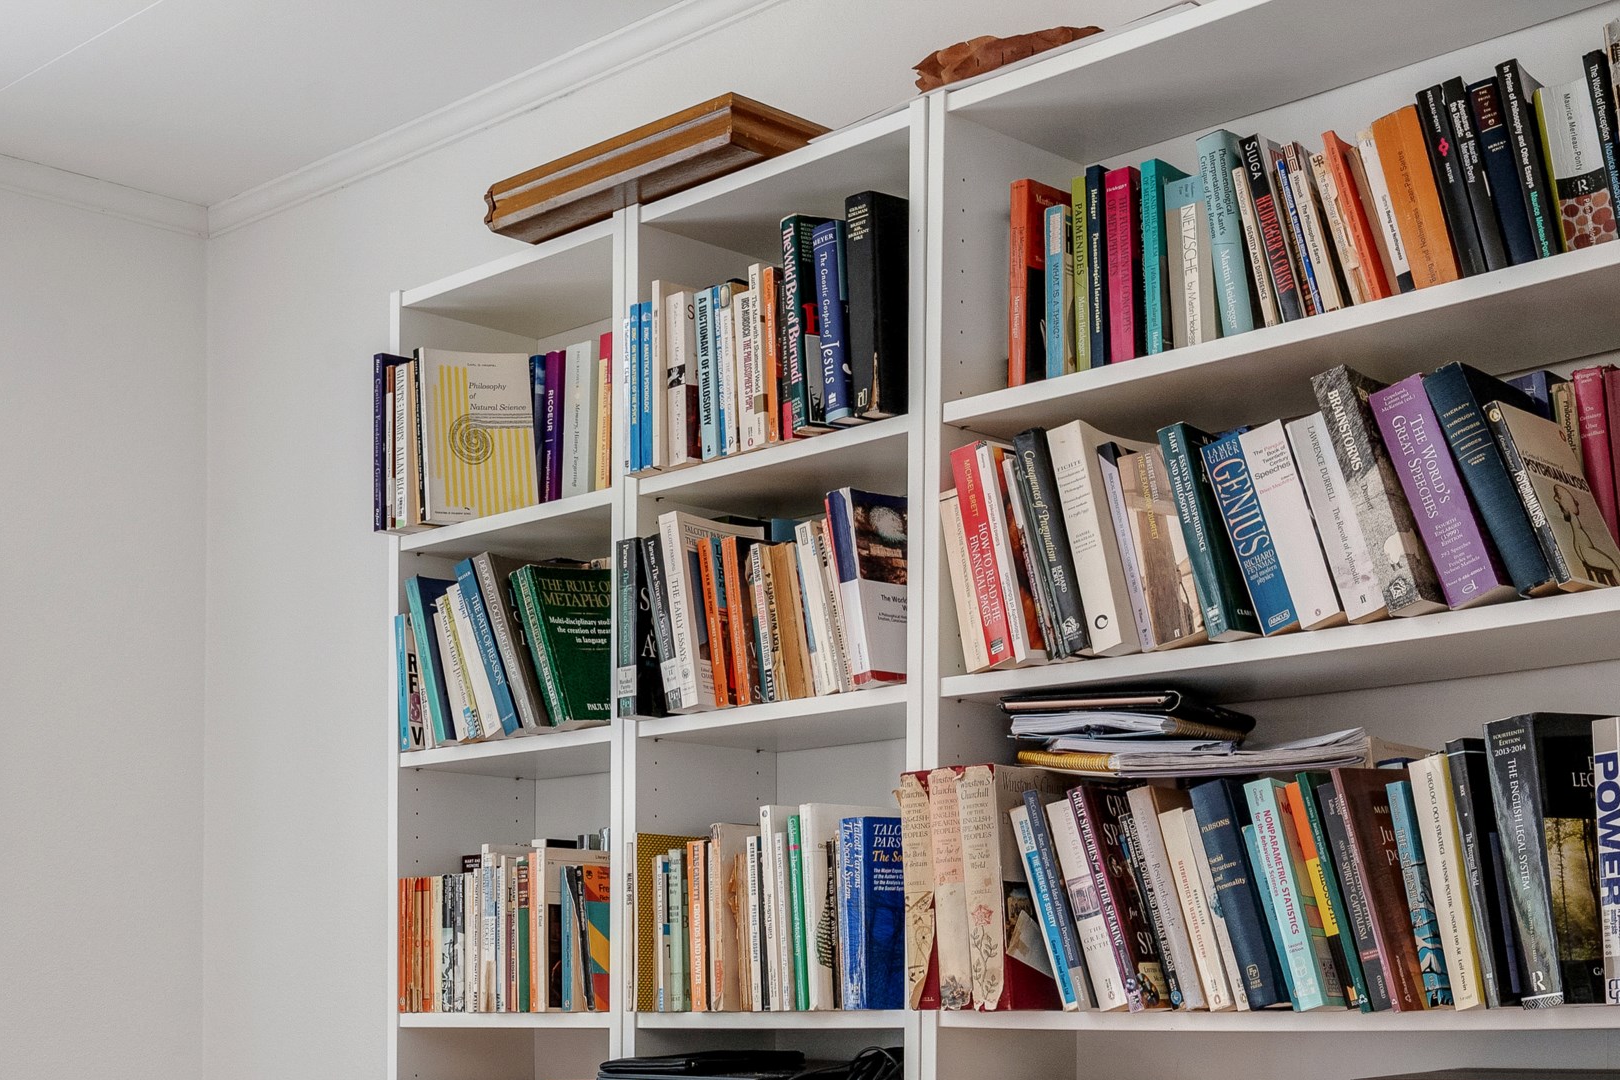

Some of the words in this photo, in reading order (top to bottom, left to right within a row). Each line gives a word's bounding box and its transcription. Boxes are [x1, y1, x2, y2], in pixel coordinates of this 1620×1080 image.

[1564, 93, 1573, 120] Maurice
[1245, 141, 1262, 180] SLUGA
[1568, 122, 1583, 171] Merleau-Ponty
[1445, 163, 1454, 183] NATURE
[783, 223, 795, 251] The
[813, 233, 834, 247] MEYER
[1075, 203, 1083, 276] PARMENIDES
[1183, 205, 1197, 276] NIETZSCHE
[1255, 194, 1280, 258] HEIDEGGER'S
[1274, 258, 1295, 293] CRISIS
[784, 250, 796, 278] Wild
[819, 252, 828, 268] The
[786, 278, 798, 309] Boy
[820, 269, 829, 297] Gnostic
[698, 297, 707, 305] A
[822, 300, 831, 327] Gospels
[787, 309, 799, 325] of
[699, 307, 710, 358] DICTIONARY
[823, 329, 831, 338] of
[701, 360, 709, 371] OF
[789, 324, 802, 384] Burundi
[819, 341, 840, 384] Jesus
[469, 382, 507, 391] Philosophy
[702, 373, 712, 426] PHILOSOPHY
[1443, 402, 1470, 419] THERAPY
[1446, 412, 1475, 428] THROUGH
[1168, 432, 1179, 454] HART
[1450, 422, 1480, 439] HYPNOSIS
[1207, 439, 1237, 457] JAMES
[1209, 447, 1240, 464] GLEICK
[1327, 388, 1363, 471] BRAINSTORMS
[1362, 484, 1373, 511] Dennett
[1409, 414, 1424, 445] THE
[1424, 444, 1451, 504] WORLD'S
[1255, 462, 1291, 480] Speeches
[1307, 425, 1323, 464] LAWRENCE
[1321, 464, 1336, 502] DURRELL
[1392, 415, 1414, 455] GREAT
[1409, 458, 1438, 519] SPEECHES
[1524, 457, 1590, 492] PSYCHOANALYSIS
[964, 460, 973, 490] MICHAEL
[970, 491, 979, 517] BRETT
[1174, 475, 1190, 524] PHILOSOPHY
[1515, 470, 1545, 527] PSYCHOANALYSIS
[1023, 450, 1042, 502] Consequences
[1039, 507, 1057, 562] Pragmatism
[1179, 454, 1189, 482] ESSAYS
[1187, 490, 1206, 552] JURISPRUDENCE
[1213, 458, 1269, 556] GENIUS
[978, 522, 990, 549] HOW
[983, 550, 992, 567] TO
[1243, 549, 1275, 569] RICHARD
[1247, 558, 1276, 574] FEYNMAN
[540, 578, 563, 589] THE
[565, 580, 597, 593] RULE
[970, 534, 986, 592] FINANCIAL
[980, 595, 993, 626] PAGES
[986, 570, 997, 598] READ
[674, 600, 683, 628] EARLY
[991, 598, 1001, 621] THE
[676, 631, 686, 662] ESSAYS
[1492, 729, 1524, 740] FOURTEENTH
[1499, 737, 1520, 746] EDITION
[1494, 744, 1526, 756] 2013-2014
[1508, 758, 1517, 778] THE
[1510, 779, 1522, 819] ENGLISH
[843, 822, 851, 837] The
[853, 821, 862, 852] Talcott
[1515, 819, 1527, 851] LEGAL
[1595, 752, 1620, 906] POWER
[873, 851, 888, 862] The
[1072, 791, 1084, 817] GREAT
[1079, 817, 1096, 863] SPEECHES
[1095, 873, 1108, 900] BETTER
[1104, 900, 1124, 947] SPEAKING
[1264, 809, 1287, 886] NONPARAMETRIC
[1283, 886, 1299, 934] STATISTICS
[1520, 853, 1530, 890] SYSTEM
[1152, 863, 1173, 928] Resultatkontrakt
